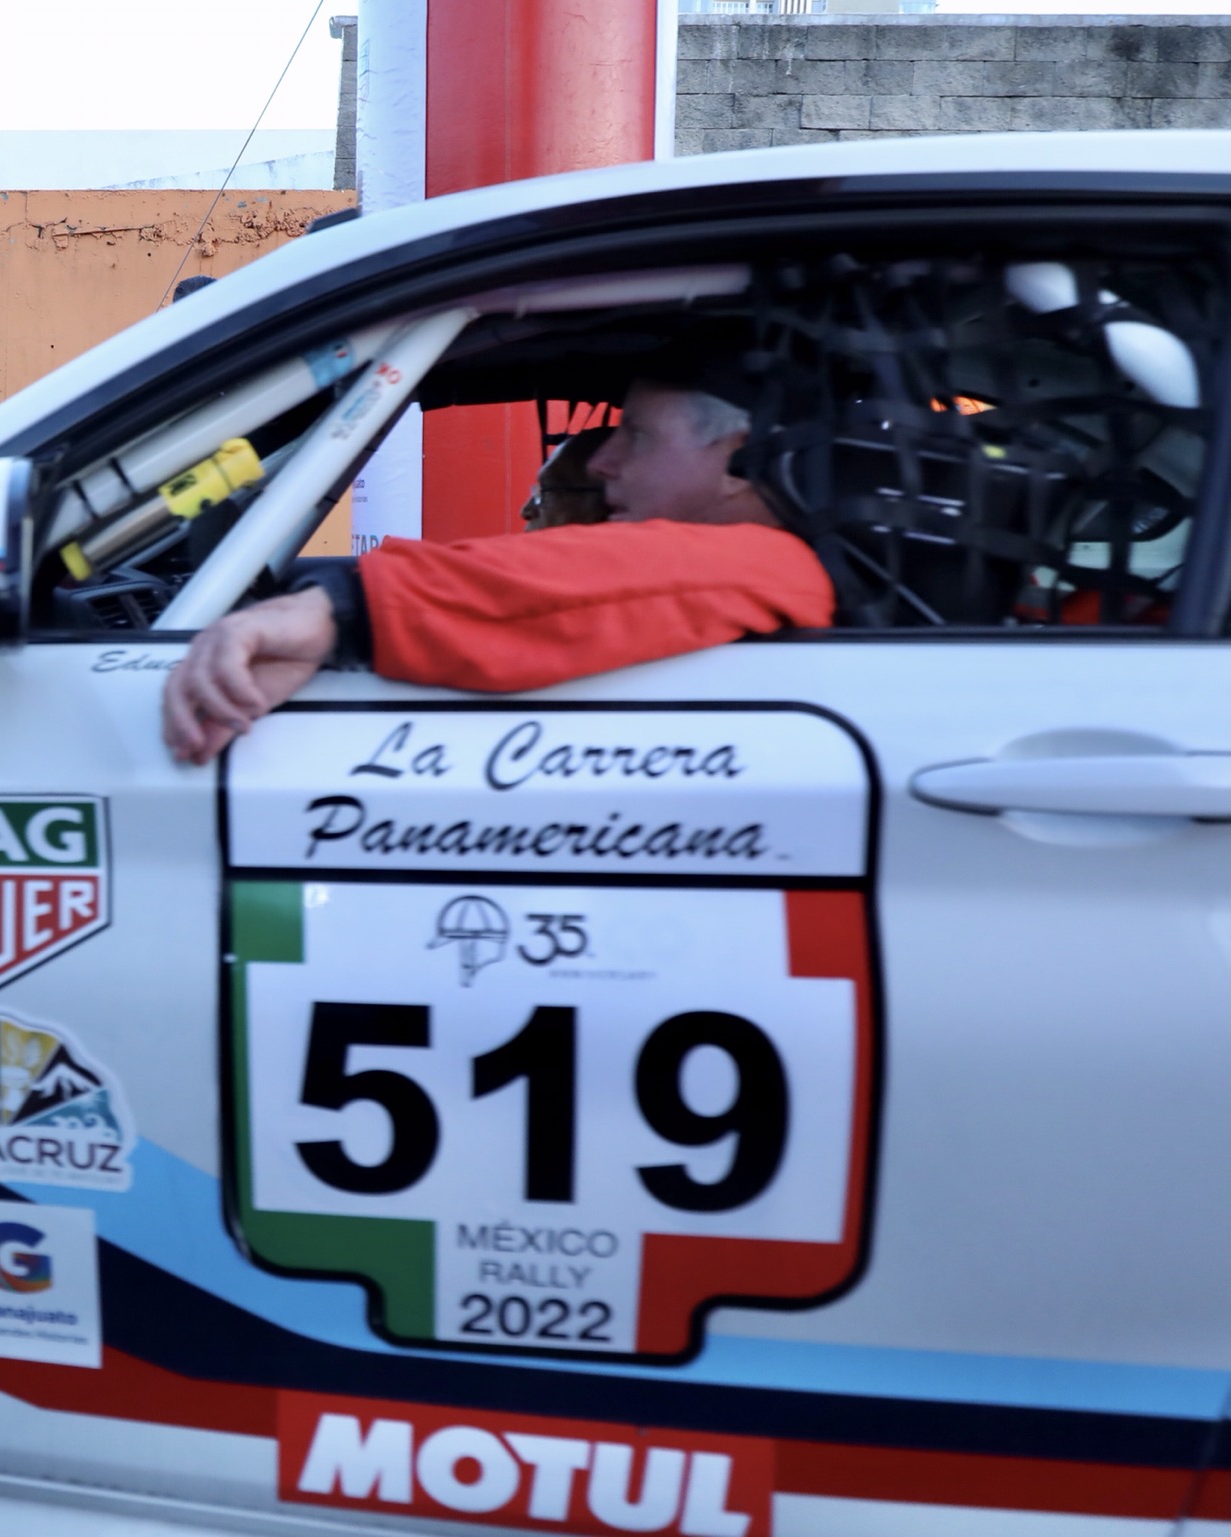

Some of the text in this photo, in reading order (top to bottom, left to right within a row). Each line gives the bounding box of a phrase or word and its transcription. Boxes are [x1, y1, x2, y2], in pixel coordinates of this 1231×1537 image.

[348, 720, 748, 791] La Carrera
[304, 795, 771, 860] Panamericana
[516, 913, 589, 966] 35
[294, 1001, 791, 1214] 519
[457, 1220, 619, 1259] MÉXICO
[478, 1260, 593, 1290] RALLY
[459, 1294, 613, 1344] 2022
[297, 1412, 752, 1537] MOTUL
